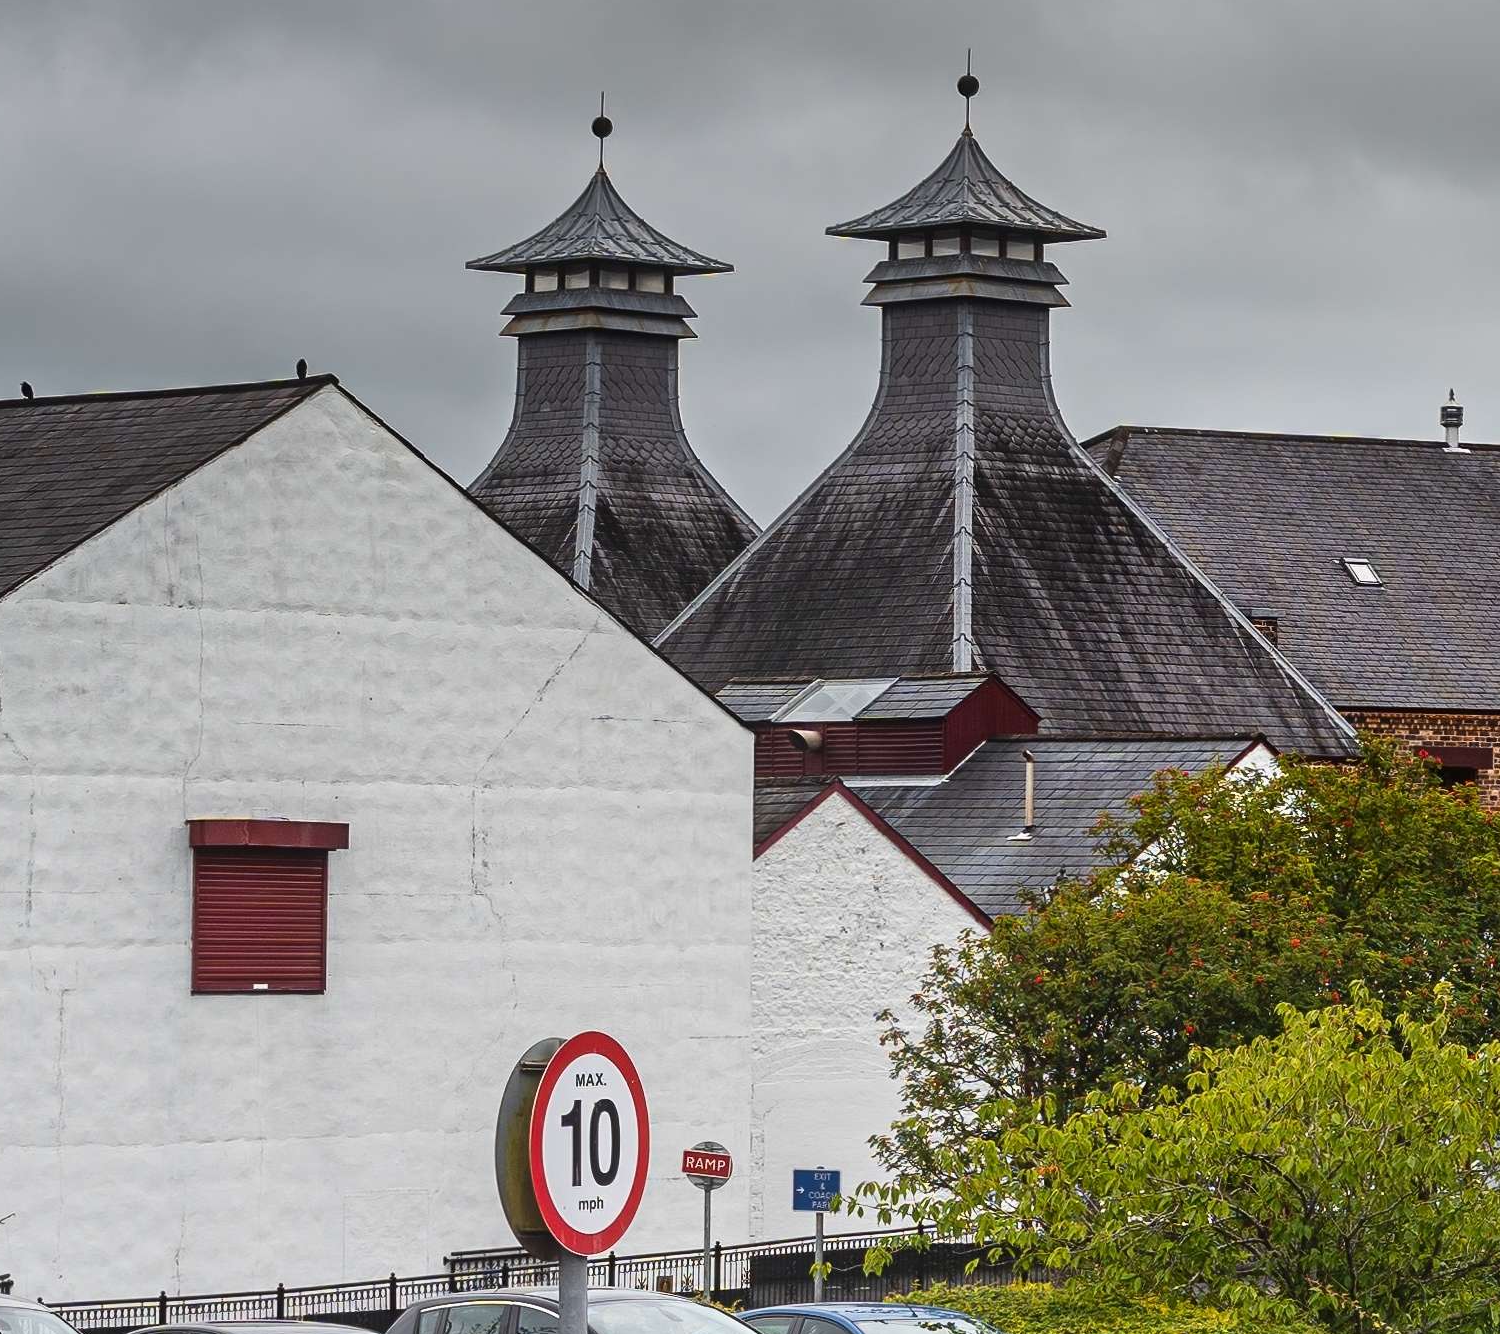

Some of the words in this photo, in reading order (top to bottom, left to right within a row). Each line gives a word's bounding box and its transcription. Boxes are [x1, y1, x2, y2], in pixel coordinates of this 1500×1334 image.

[575, 1072, 607, 1087] MAX.
[560, 1098, 621, 1187] 10
[685, 1156, 727, 1173] RAMP
[814, 1172, 831, 1181] EXIT
[578, 1196, 604, 1212] mph
[812, 1201, 831, 1209] PAR
